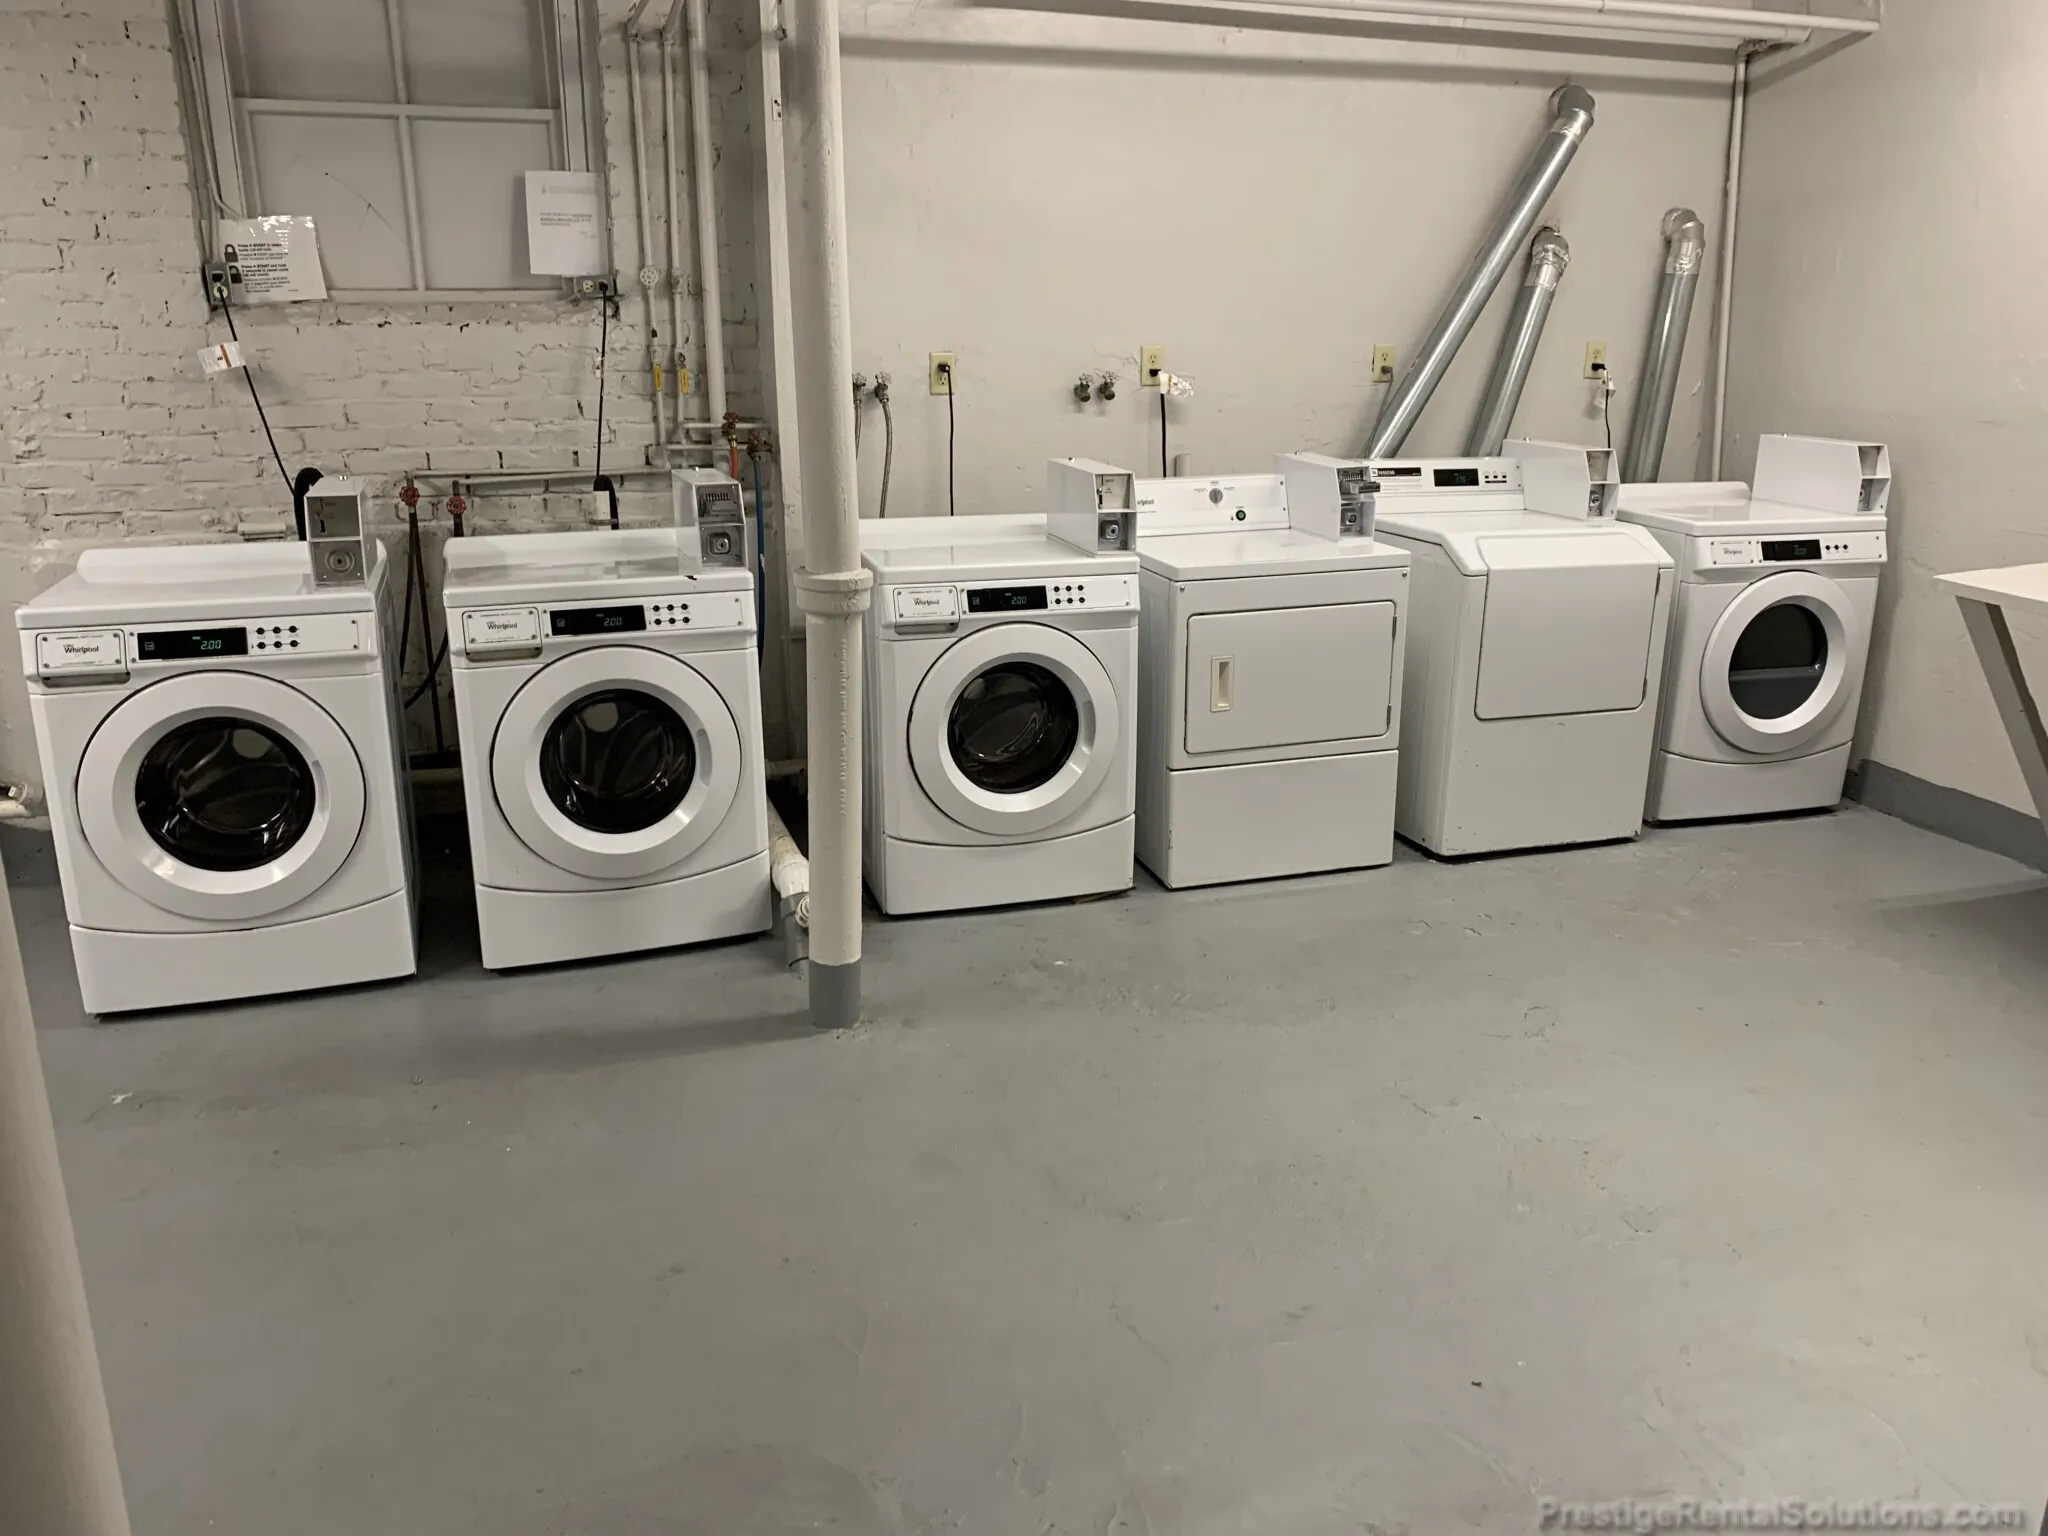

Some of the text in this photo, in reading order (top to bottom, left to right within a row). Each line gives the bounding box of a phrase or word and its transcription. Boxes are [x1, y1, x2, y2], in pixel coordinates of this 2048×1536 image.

[1136, 498, 1155, 507] irlpool
[913, 598, 940, 606] Whirlpool
[603, 616, 623, 627] 2.00
[487, 622, 518, 631] Whirlpool
[200, 639, 222, 650] 2.00
[64, 645, 100, 655] Whirlpool
